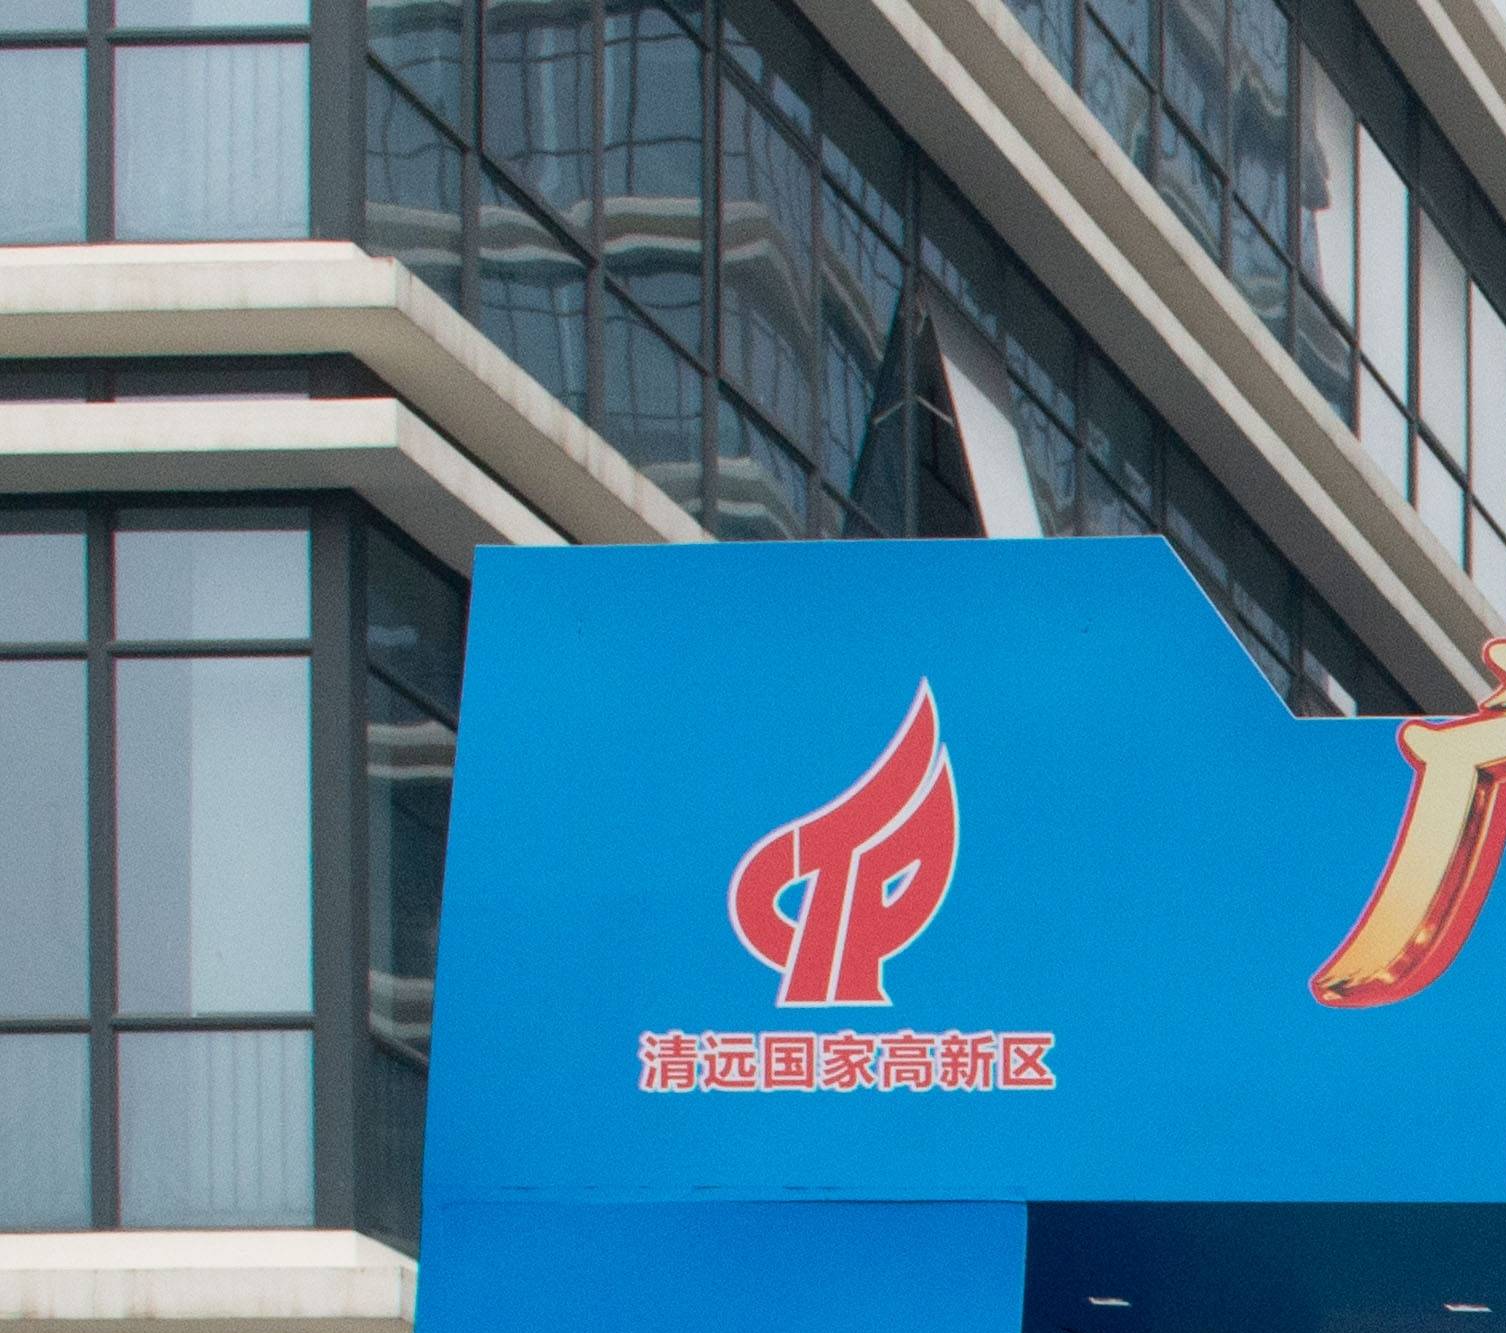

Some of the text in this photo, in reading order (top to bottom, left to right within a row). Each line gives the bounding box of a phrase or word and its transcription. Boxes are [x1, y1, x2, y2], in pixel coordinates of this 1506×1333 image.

[639, 1029, 1057, 1093] 清远国家高新区
